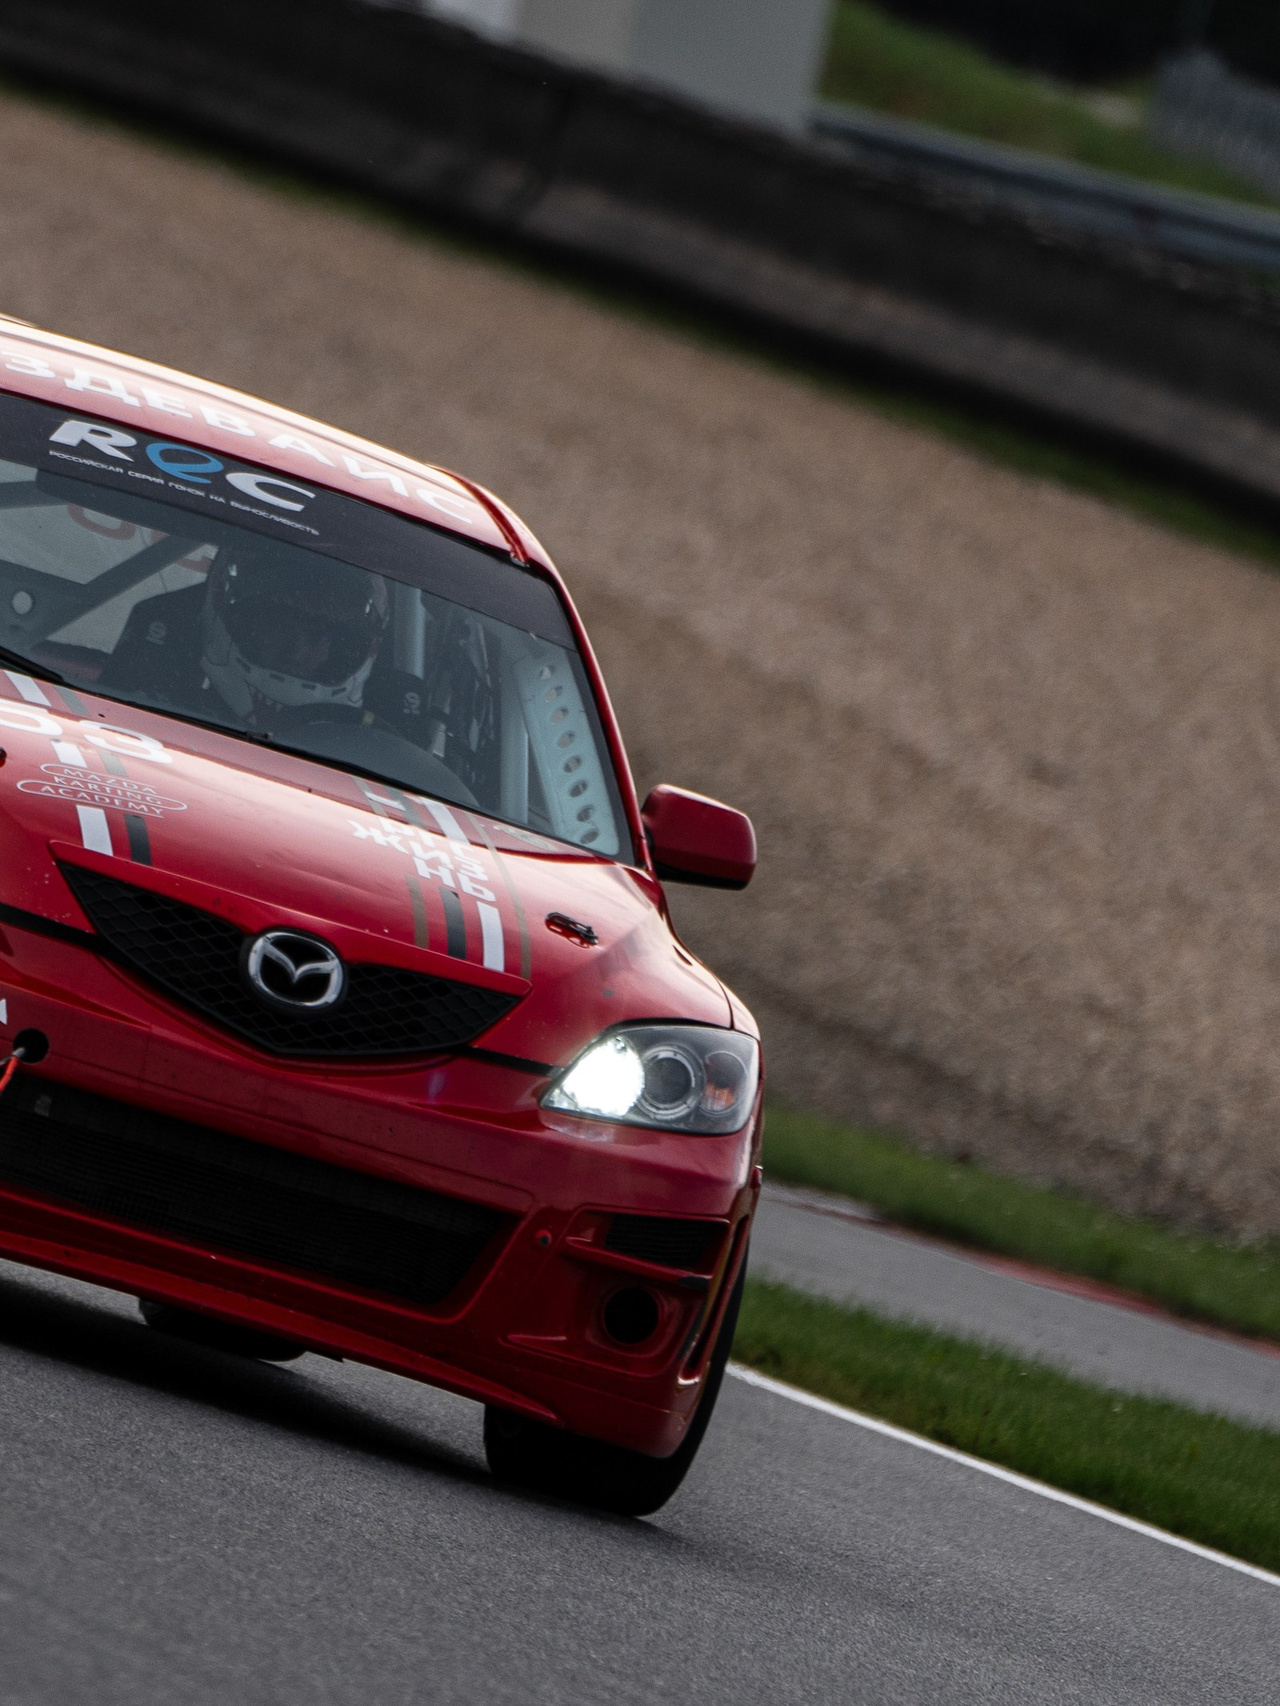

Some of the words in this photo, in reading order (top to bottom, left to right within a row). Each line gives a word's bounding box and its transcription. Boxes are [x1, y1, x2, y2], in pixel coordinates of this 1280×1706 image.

[53, 776, 163, 806] KARTING
[63, 768, 157, 795] MAZDA
[40, 785, 165, 815] ACADEMY
